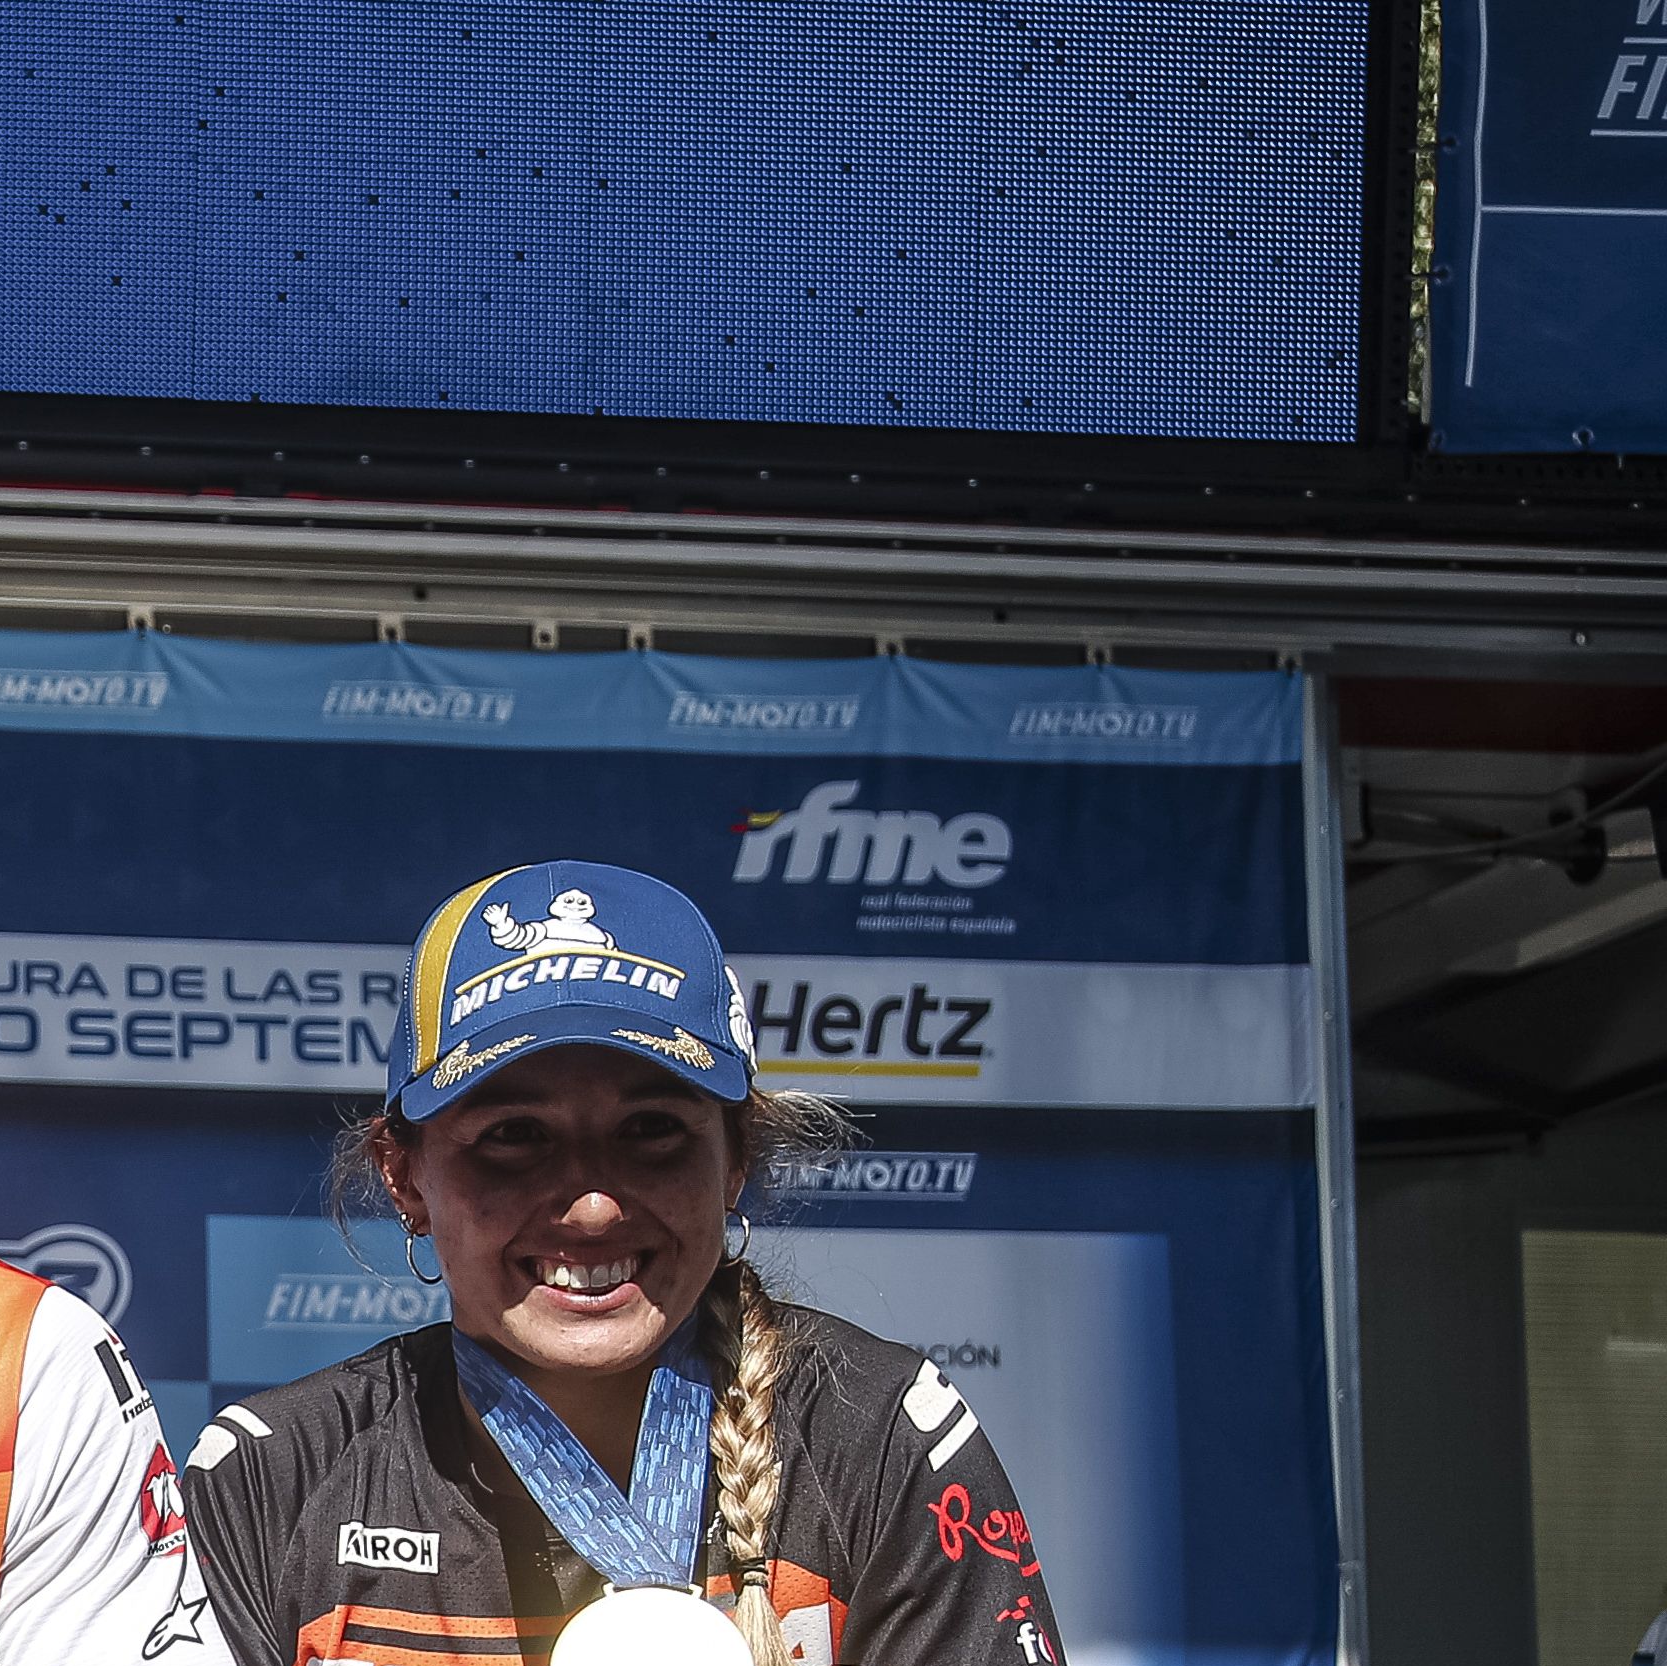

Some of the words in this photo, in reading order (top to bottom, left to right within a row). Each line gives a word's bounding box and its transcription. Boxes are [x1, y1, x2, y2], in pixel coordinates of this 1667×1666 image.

[731, 779, 1014, 889] rfme
[128, 962, 206, 1001] DE
[223, 965, 327, 1005] LAS
[448, 954, 683, 1029] MICHELIN
[753, 978, 993, 1060] Hertz
[345, 1524, 435, 1570] AIROH
